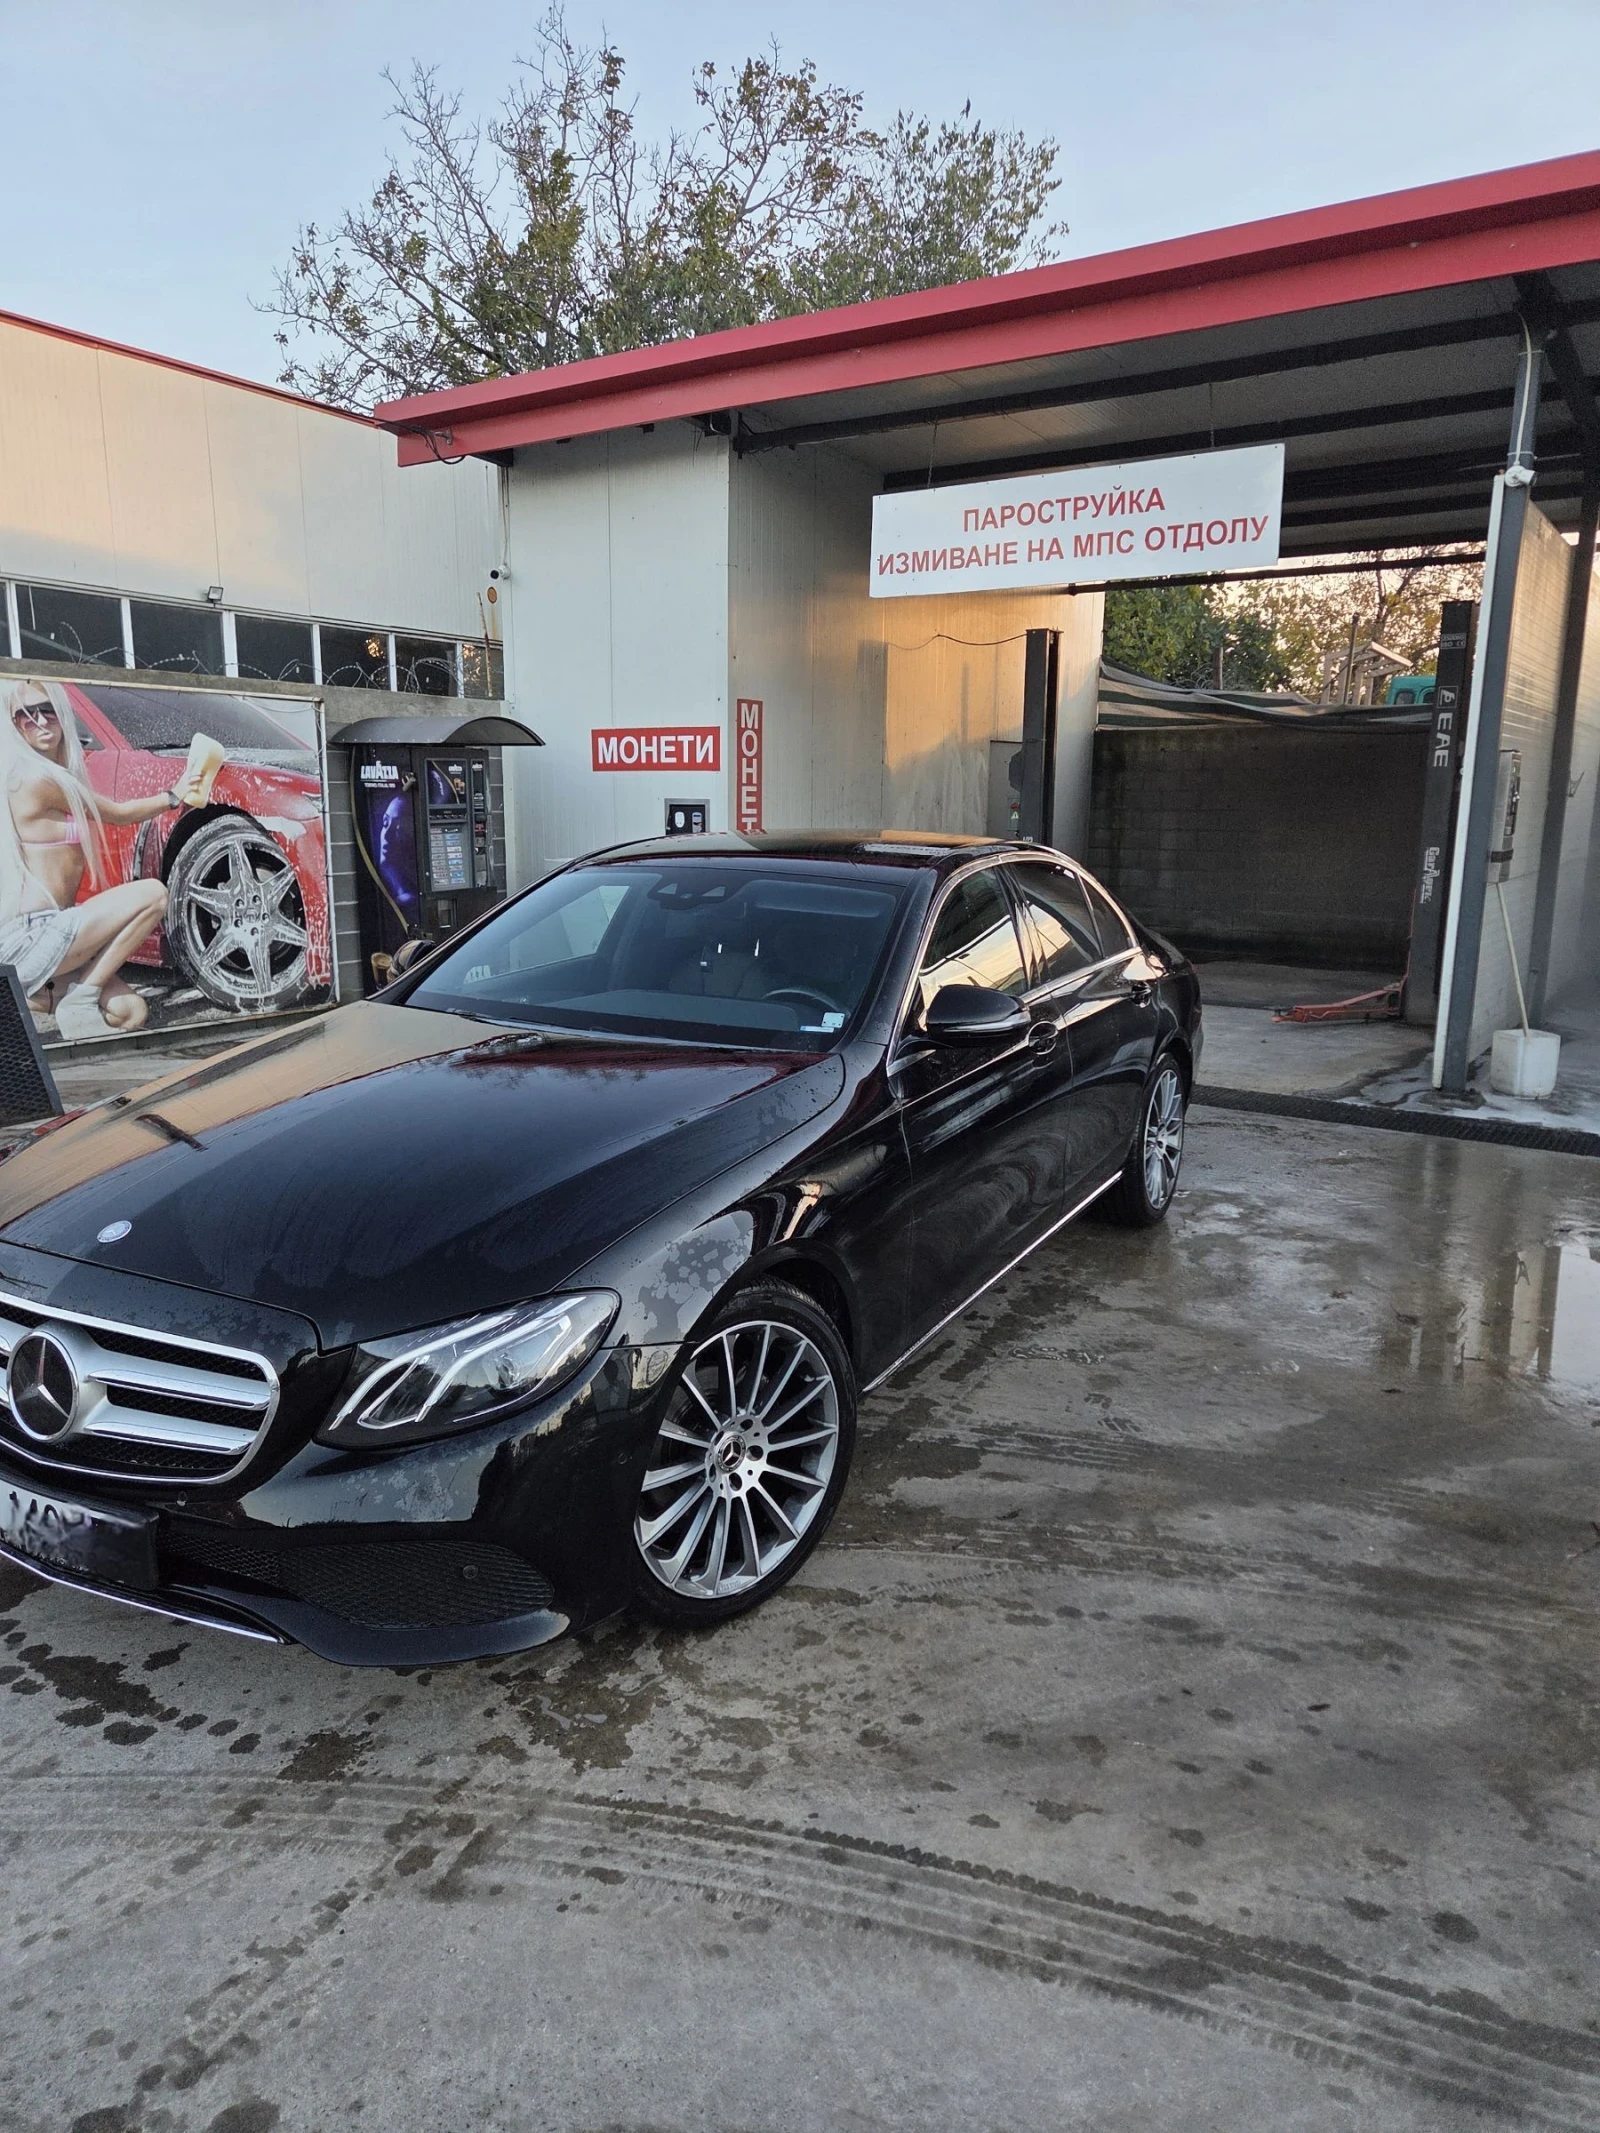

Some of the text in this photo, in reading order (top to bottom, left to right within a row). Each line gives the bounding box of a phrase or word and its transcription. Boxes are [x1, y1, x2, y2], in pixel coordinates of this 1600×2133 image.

[963, 484, 1166, 532] ПАРОСТРУЙКА
[878, 515, 1269, 576] ИЗМИВАНЕ НА МПС ОТДОЛУ
[597, 735, 714, 764] МОНЕТИ
[1433, 712, 1453, 768] EAE
[360, 760, 399, 780] LAVAZZA
